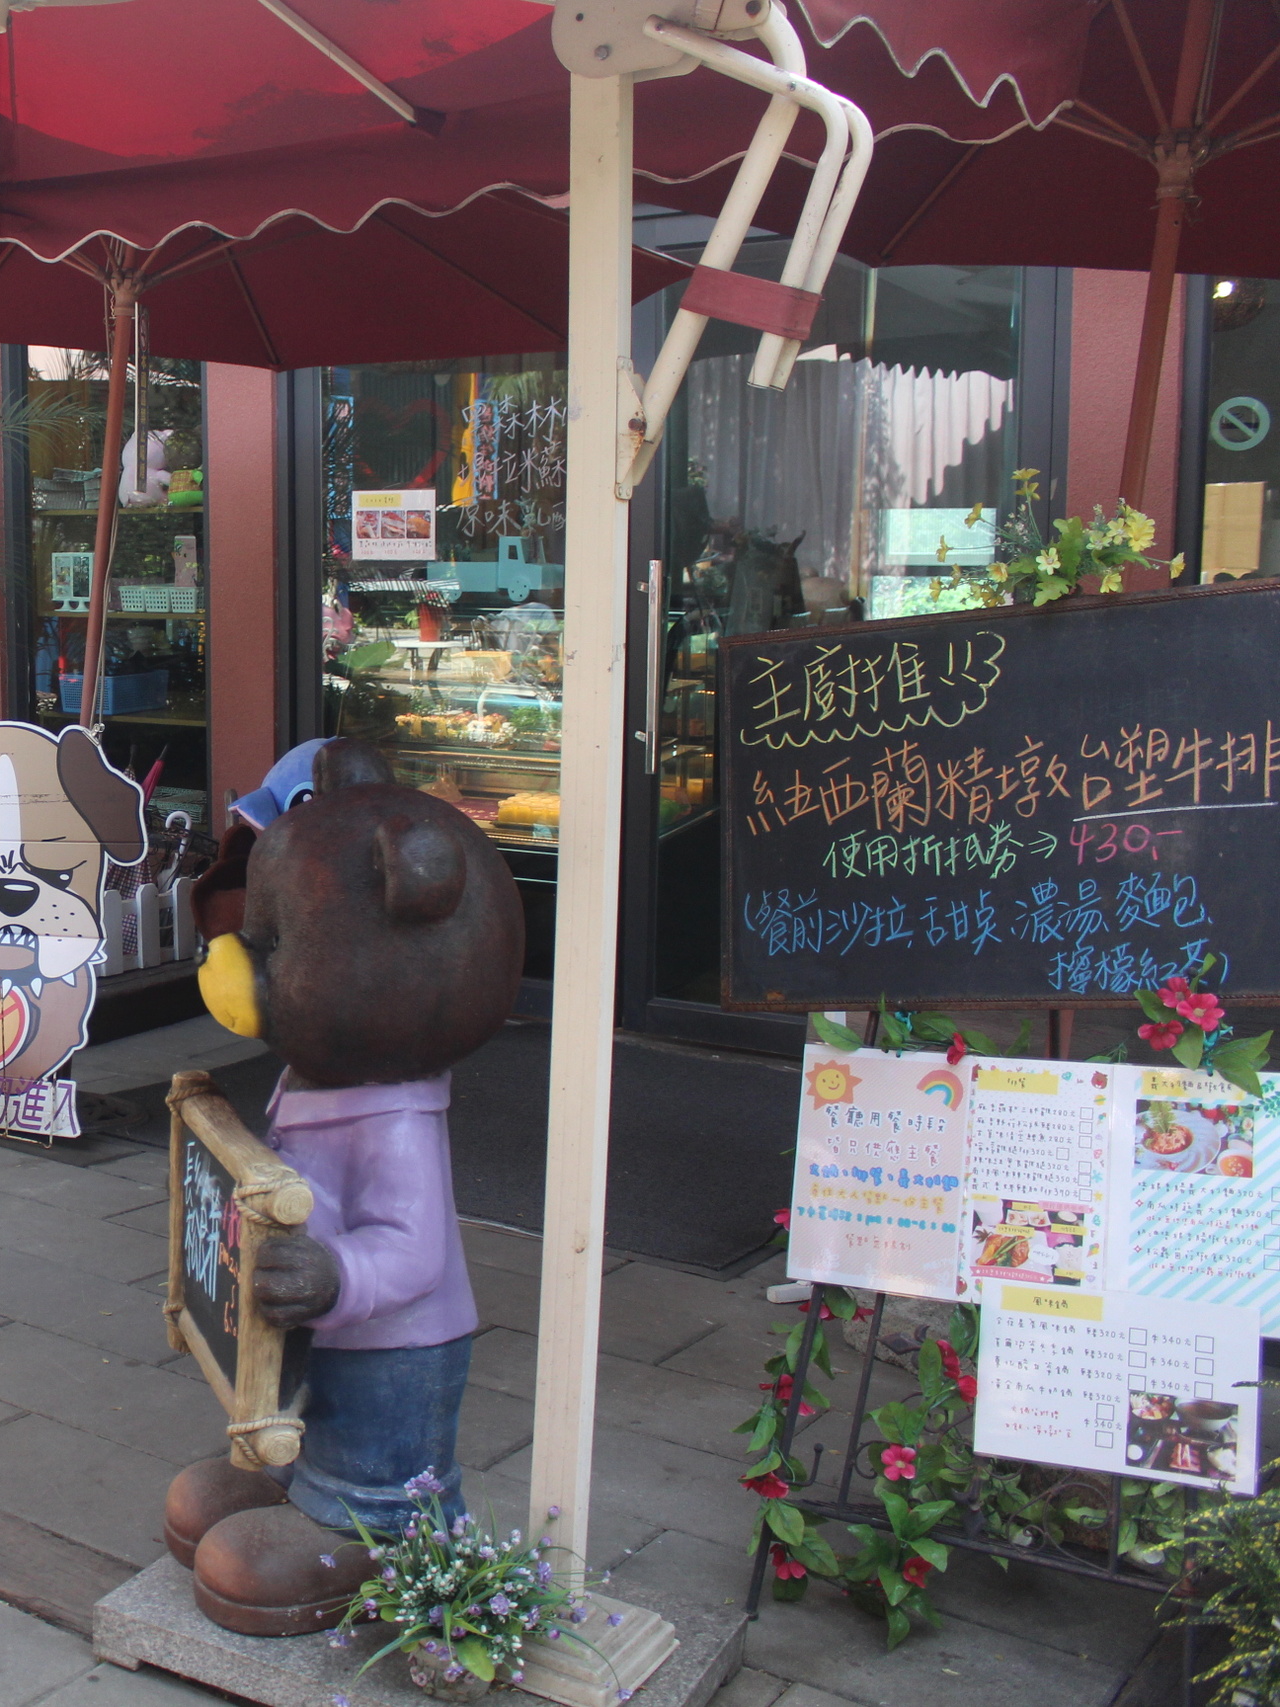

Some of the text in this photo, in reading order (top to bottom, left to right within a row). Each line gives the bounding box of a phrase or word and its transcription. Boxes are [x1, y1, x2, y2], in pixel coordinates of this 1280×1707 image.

[825, 1105, 947, 1134] 餐廳用餐時段
